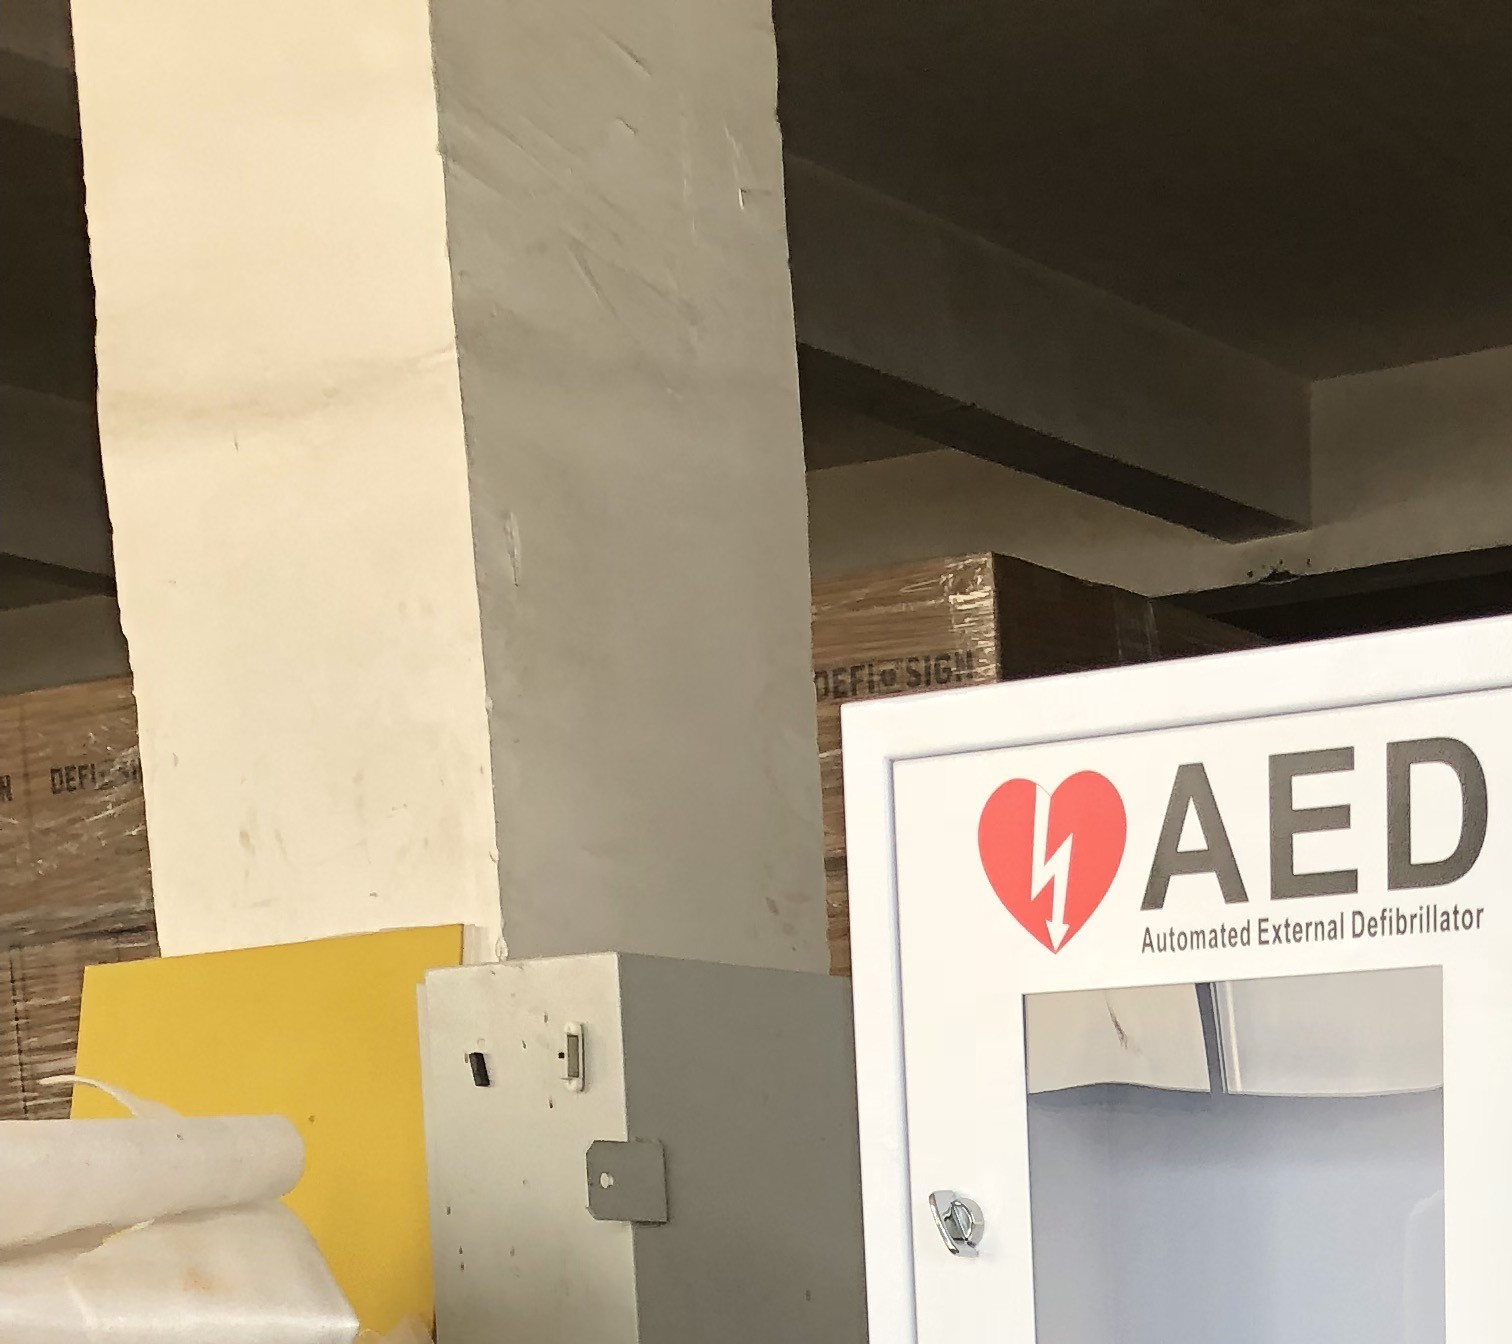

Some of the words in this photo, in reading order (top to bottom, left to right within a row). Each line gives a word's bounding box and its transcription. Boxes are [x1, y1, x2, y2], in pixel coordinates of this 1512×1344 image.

[905, 649, 974, 688] SIGN
[50, 763, 96, 795] DEFI
[1140, 737, 1488, 911] AED
[1141, 919, 1251, 955] Automated
[1258, 911, 1345, 946] External
[1351, 904, 1485, 939] Defibrillator
